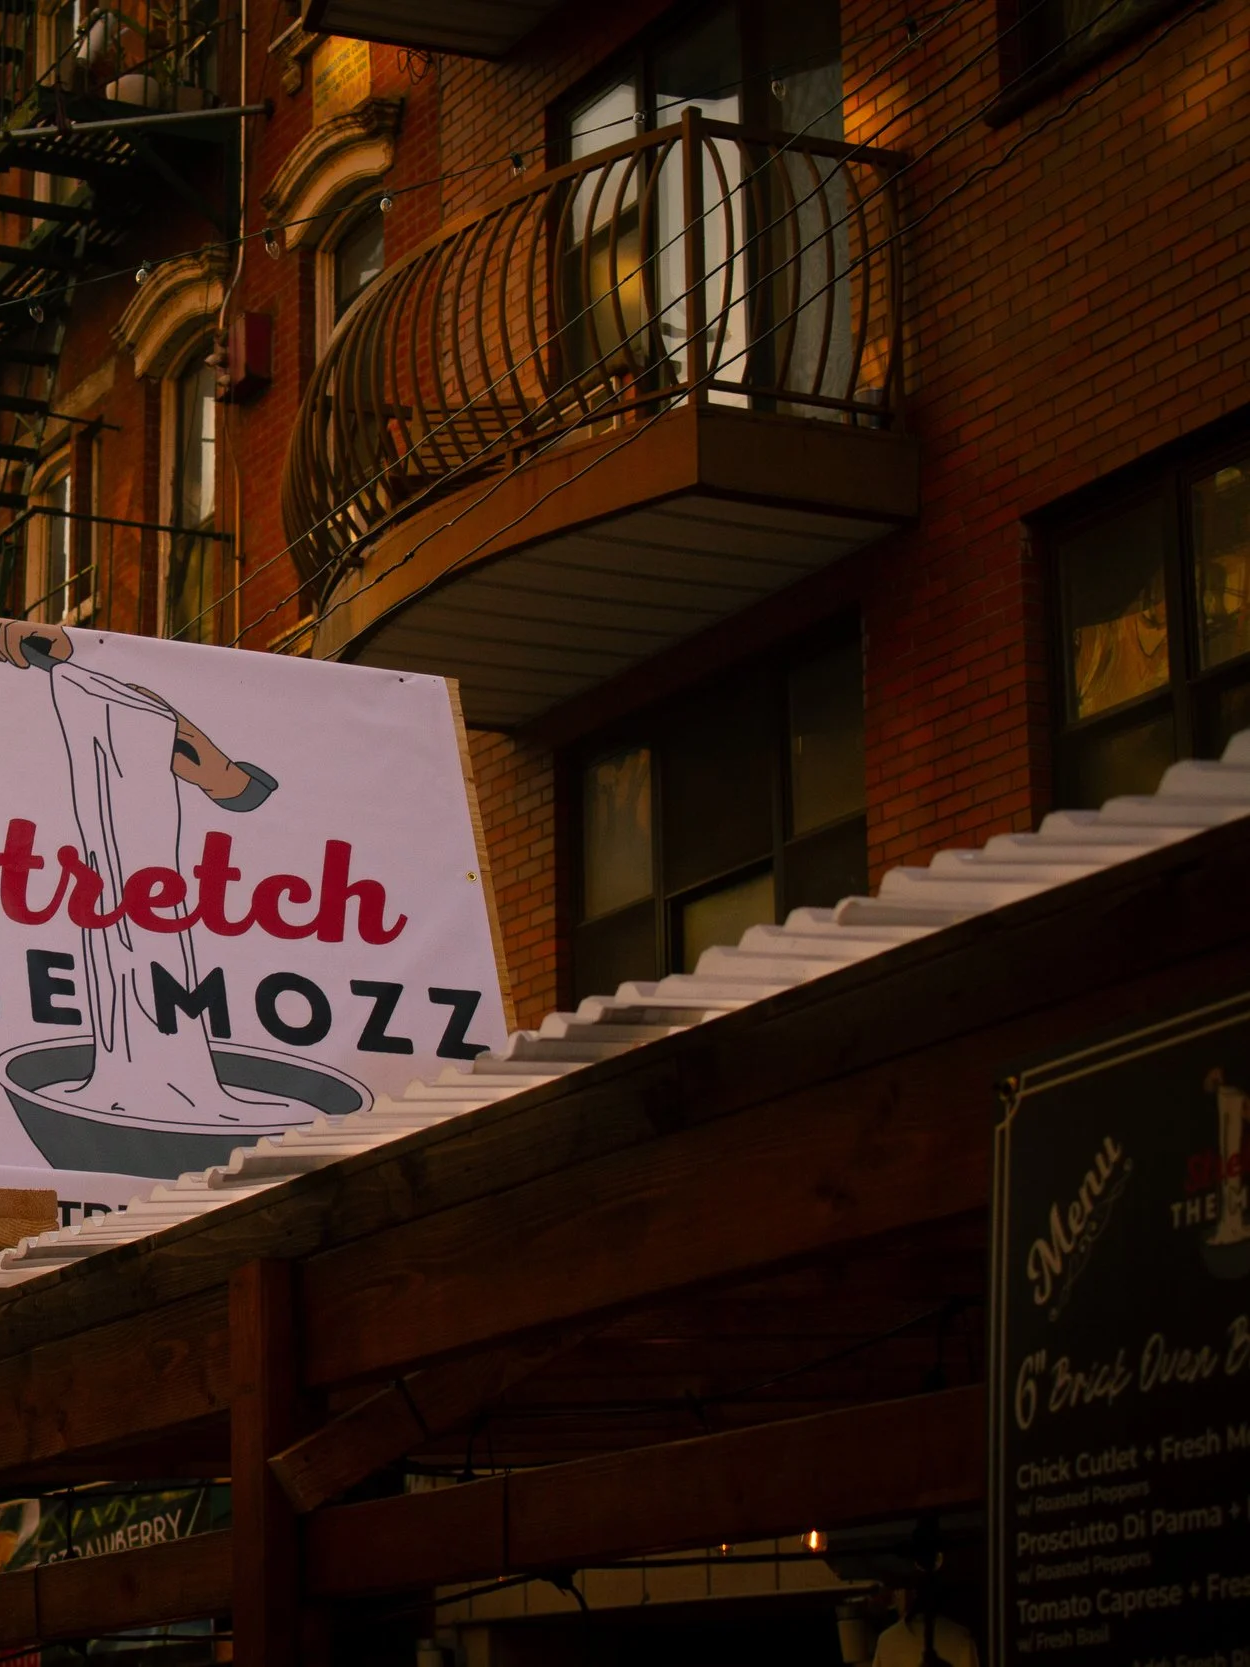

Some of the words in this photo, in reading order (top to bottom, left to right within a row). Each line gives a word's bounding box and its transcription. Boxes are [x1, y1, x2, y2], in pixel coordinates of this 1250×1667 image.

[150, 961, 491, 1060] MOZZ
[1026, 1136, 1123, 1305] Menu
[1171, 1192, 1217, 1231] THE
[1014, 1347, 1047, 1431] 6"
[1047, 1347, 1134, 1414] Brick
[1138, 1332, 1220, 1393] Oven
[1015, 1456, 1072, 1491] Chick
[1074, 1444, 1138, 1480] Cutlet
[1159, 1424, 1222, 1464] Fresh
[1091, 1478, 1151, 1506] Peppers
[1015, 1519, 1119, 1557] Prosciutto
[1121, 1508, 1149, 1541] Di
[1151, 1503, 1224, 1538] Parma
[1092, 1549, 1152, 1575] Peppers
[1015, 1592, 1093, 1625] Tomato
[1095, 1582, 1186, 1619] Caprese
[1075, 1621, 1111, 1647] Basil
